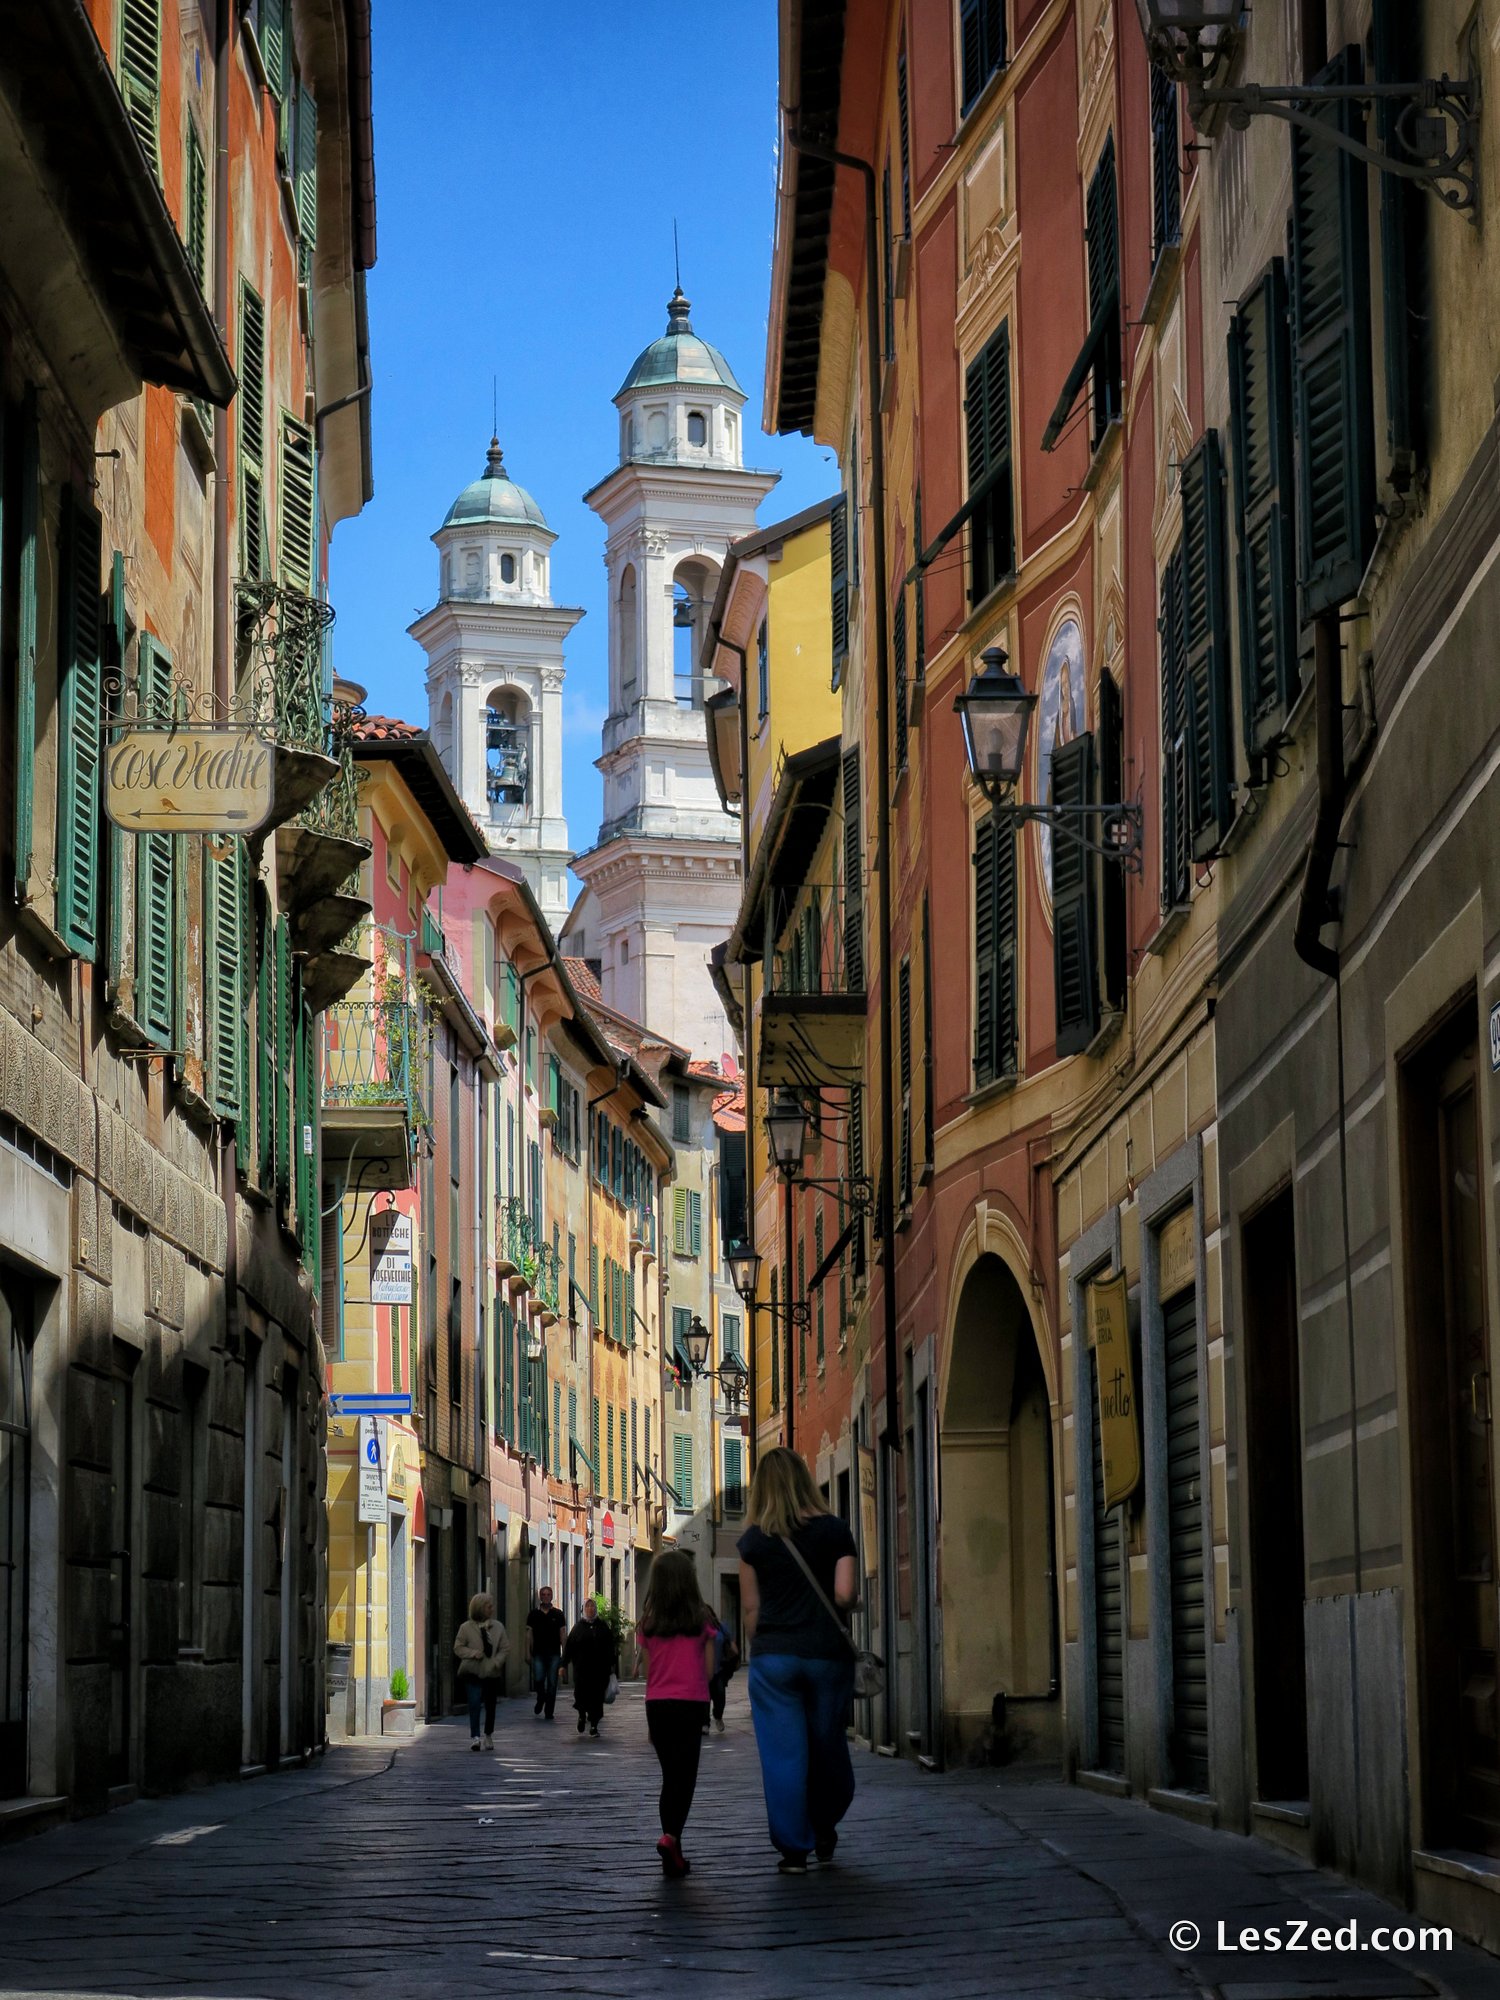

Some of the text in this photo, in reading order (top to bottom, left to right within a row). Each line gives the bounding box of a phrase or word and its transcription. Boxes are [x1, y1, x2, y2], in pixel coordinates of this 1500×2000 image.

[110, 735, 268, 790] Cose Vecchie
[372, 1226, 410, 1239] BOTTEGHE
[386, 1257, 395, 1269] DI
[372, 1269, 411, 1283] COSEVECCHIE
